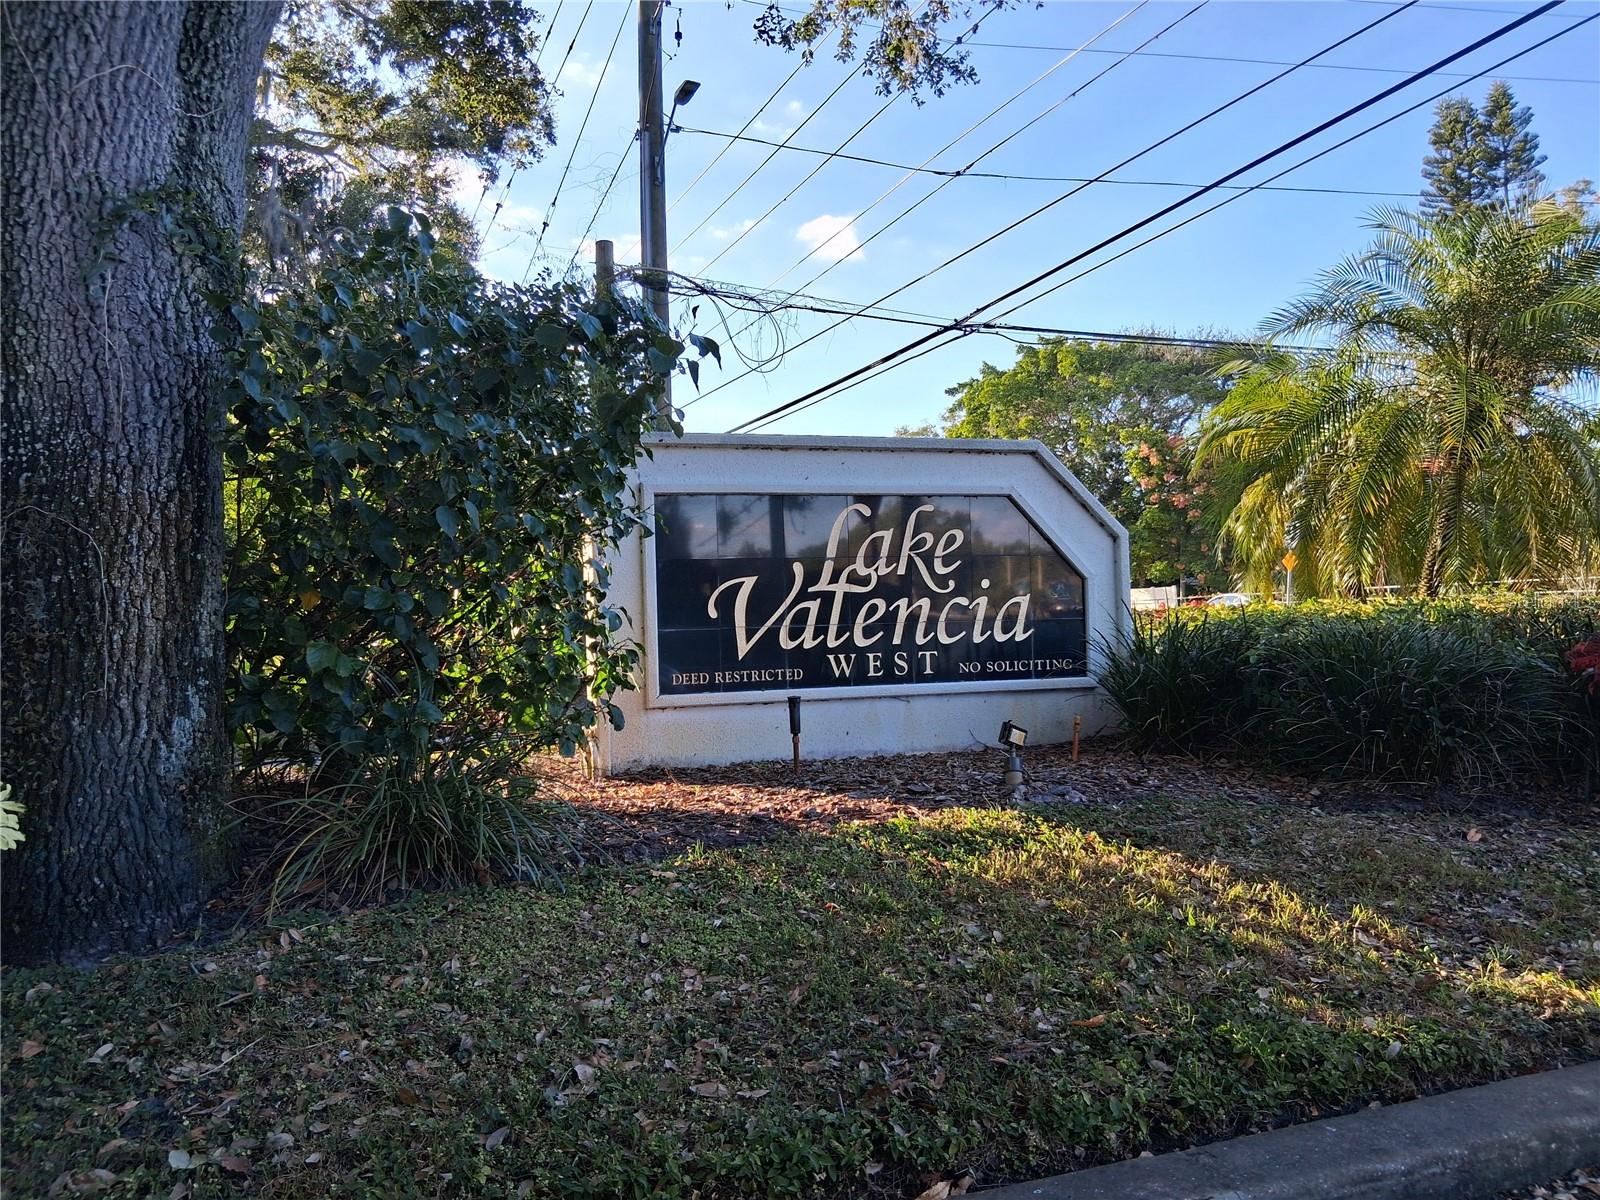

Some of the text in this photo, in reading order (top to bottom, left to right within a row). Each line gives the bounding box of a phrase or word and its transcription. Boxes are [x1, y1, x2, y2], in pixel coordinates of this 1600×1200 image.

[807, 503, 965, 594] Lake
[707, 561, 1035, 662] Valencia
[672, 668, 803, 686] DEED RESTRICTED
[826, 650, 939, 679] WEST
[959, 658, 1073, 674] NO SOLICITING
